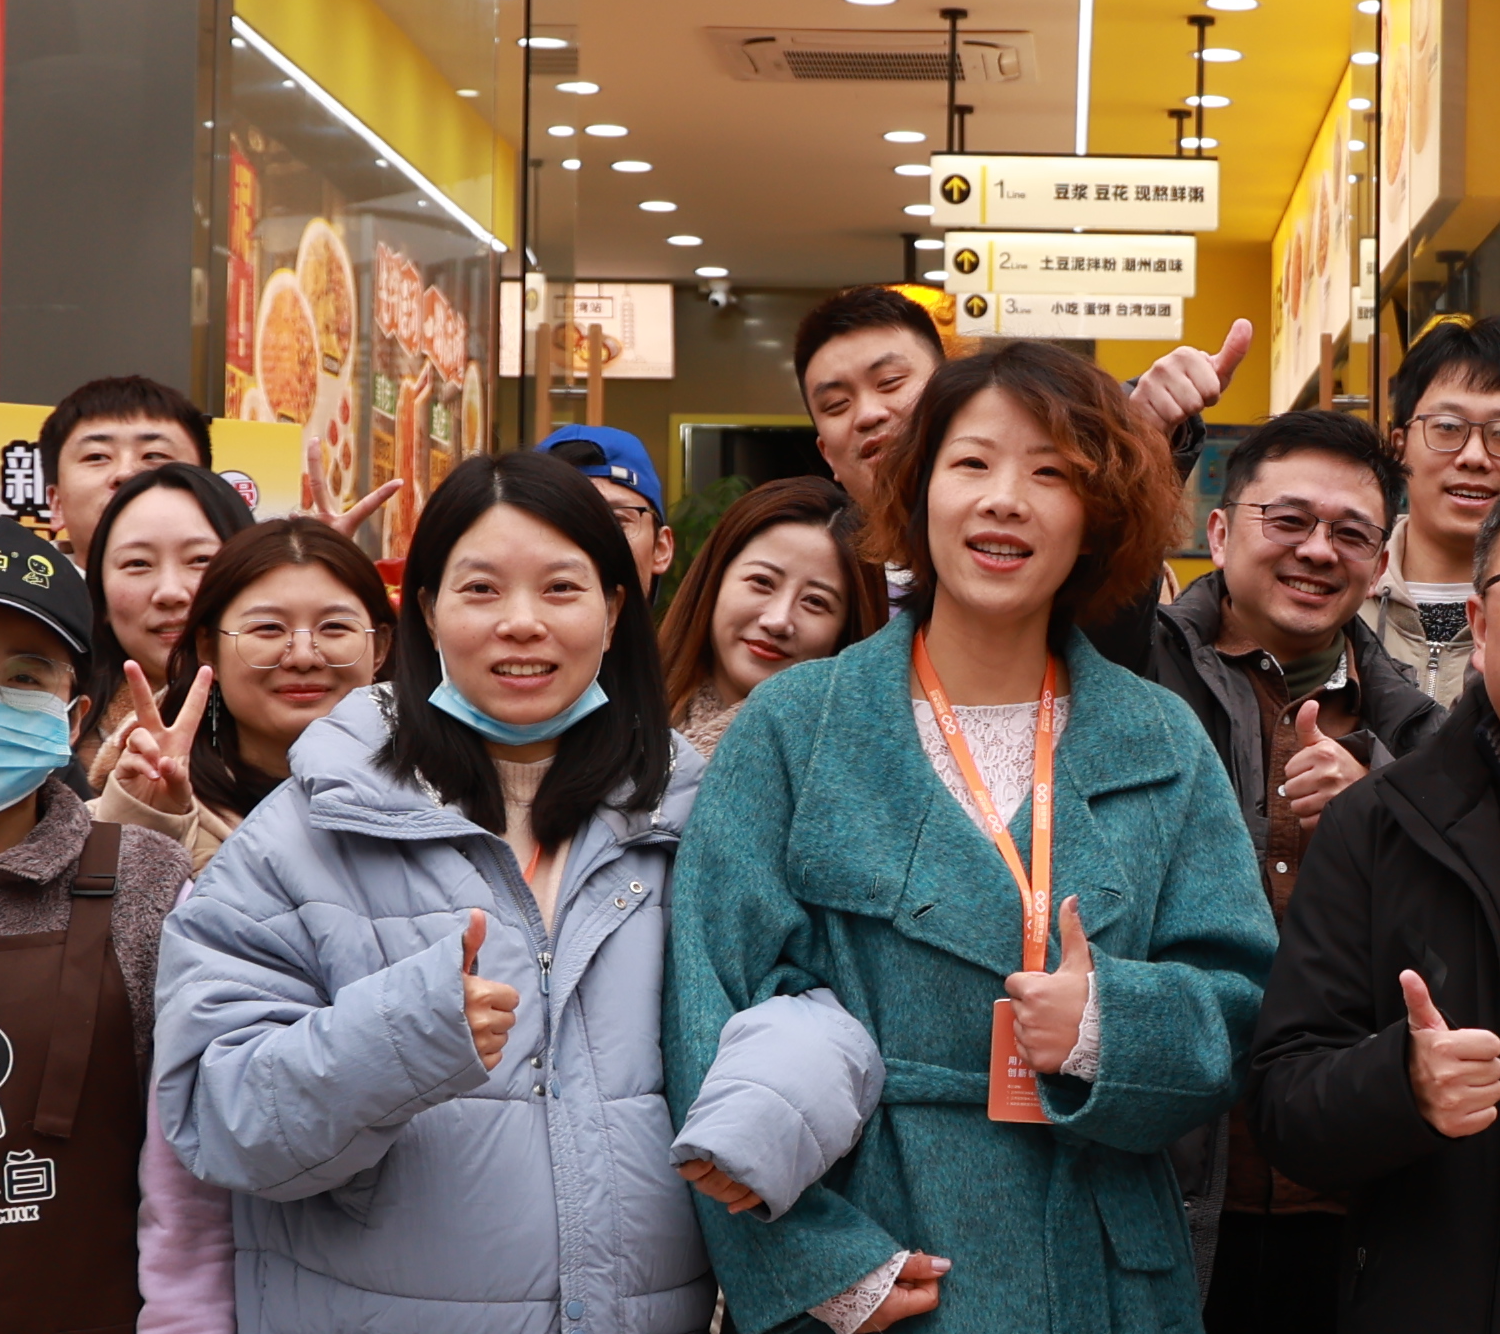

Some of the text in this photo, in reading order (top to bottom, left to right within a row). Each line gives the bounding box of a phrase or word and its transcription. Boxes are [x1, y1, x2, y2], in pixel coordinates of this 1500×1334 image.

[1053, 183, 1088, 202] 豆浆
[1094, 183, 1129, 203] 豆花
[1134, 184, 1205, 204] 现熬鲜粥
[1040, 255, 1117, 273] 土豆泥拌粉
[1121, 257, 1184, 274] 潮州卤味
[1050, 301, 1079, 316] 小吃
[1084, 302, 1111, 316] 蛋饼
[1115, 302, 1173, 318] 台湾饭团
